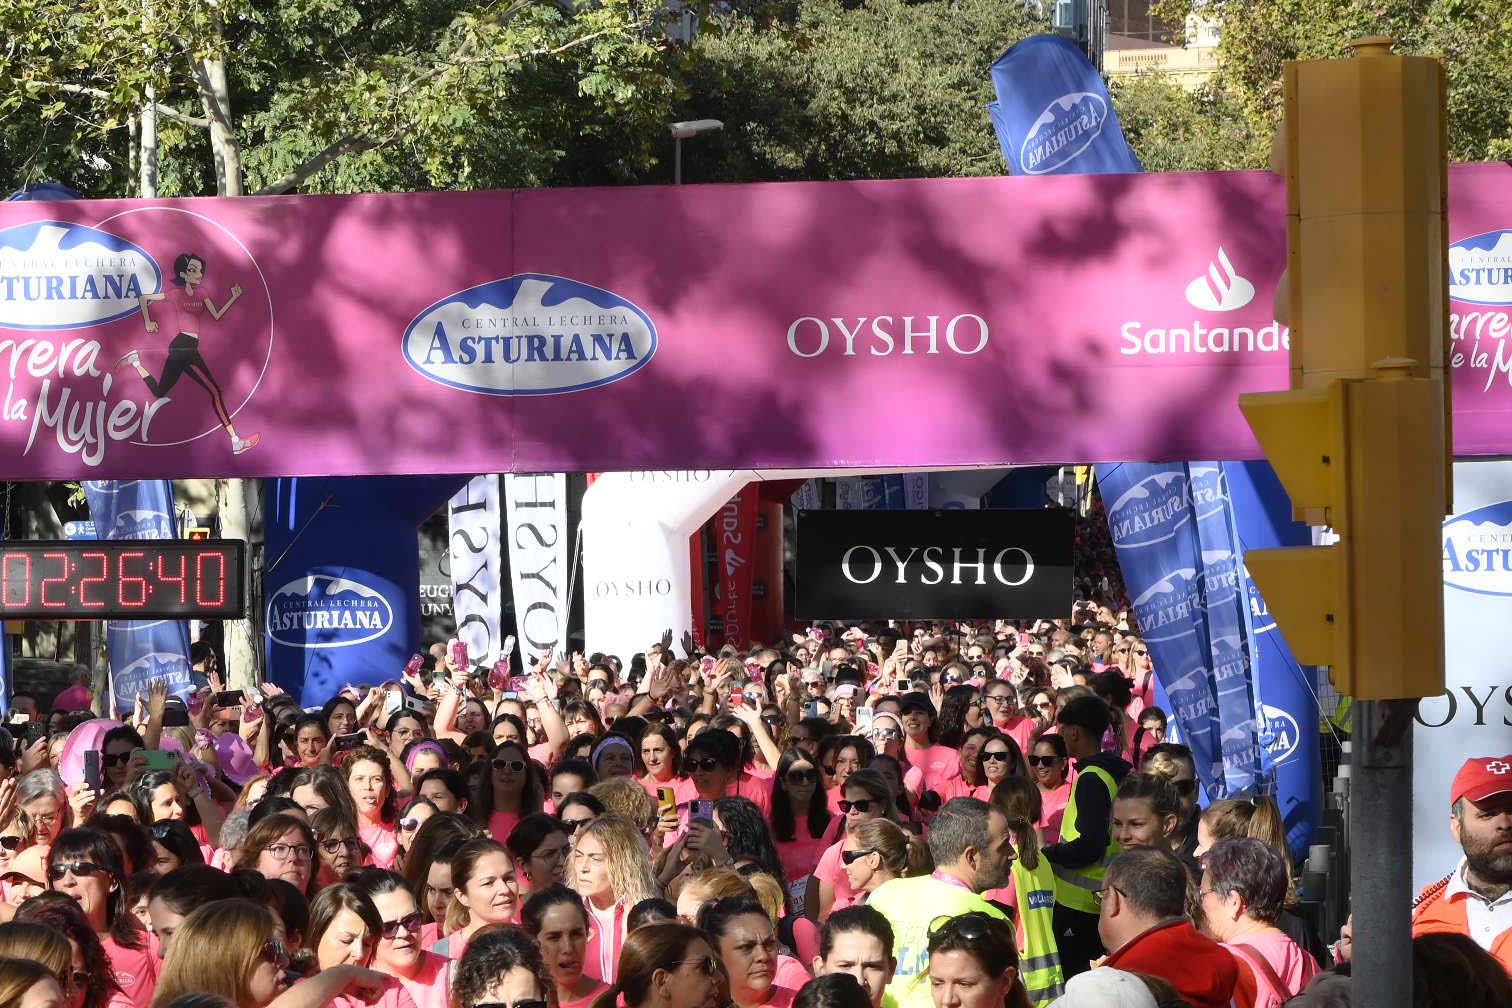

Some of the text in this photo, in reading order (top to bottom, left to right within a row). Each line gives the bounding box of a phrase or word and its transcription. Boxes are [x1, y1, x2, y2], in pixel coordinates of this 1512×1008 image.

[461, 314, 629, 329] CENTRAL LECHERA
[786, 313, 990, 358] OYSHO
[421, 321, 639, 365] ASTURIANA
[3, 383, 28, 421] la
[24, 373, 172, 467] Mujer
[1, 552, 226, 607] 02:26:40
[841, 545, 1035, 586] OYSHO
[329, 599, 379, 608] LECHERA
[596, 577, 672, 599] OYSHO
[269, 604, 384, 632] ASTURIANA
